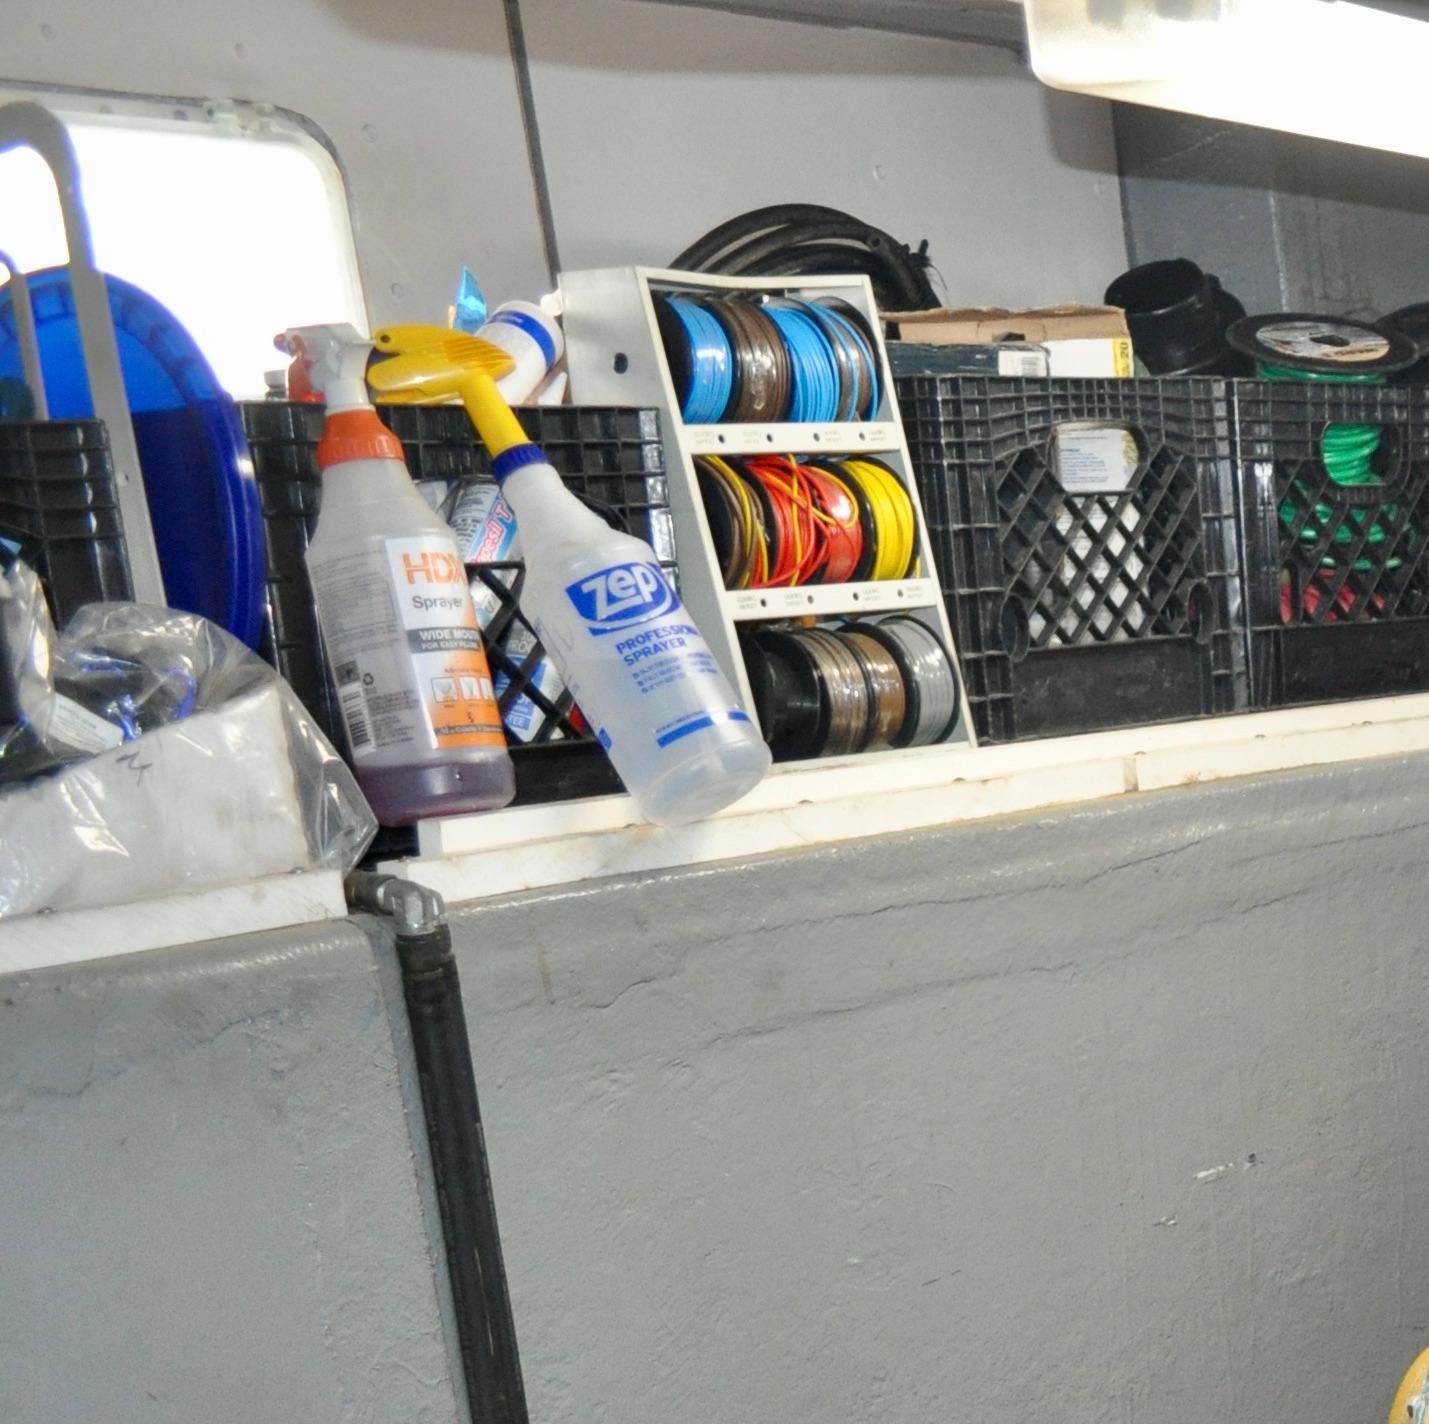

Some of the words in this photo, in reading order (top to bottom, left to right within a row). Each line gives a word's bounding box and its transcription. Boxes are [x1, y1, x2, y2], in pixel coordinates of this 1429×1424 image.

[402, 553, 469, 585] HDX
[412, 595, 464, 609] Sprayer
[419, 629, 451, 640] WIDE
[623, 637, 688, 666] SPRAYER
